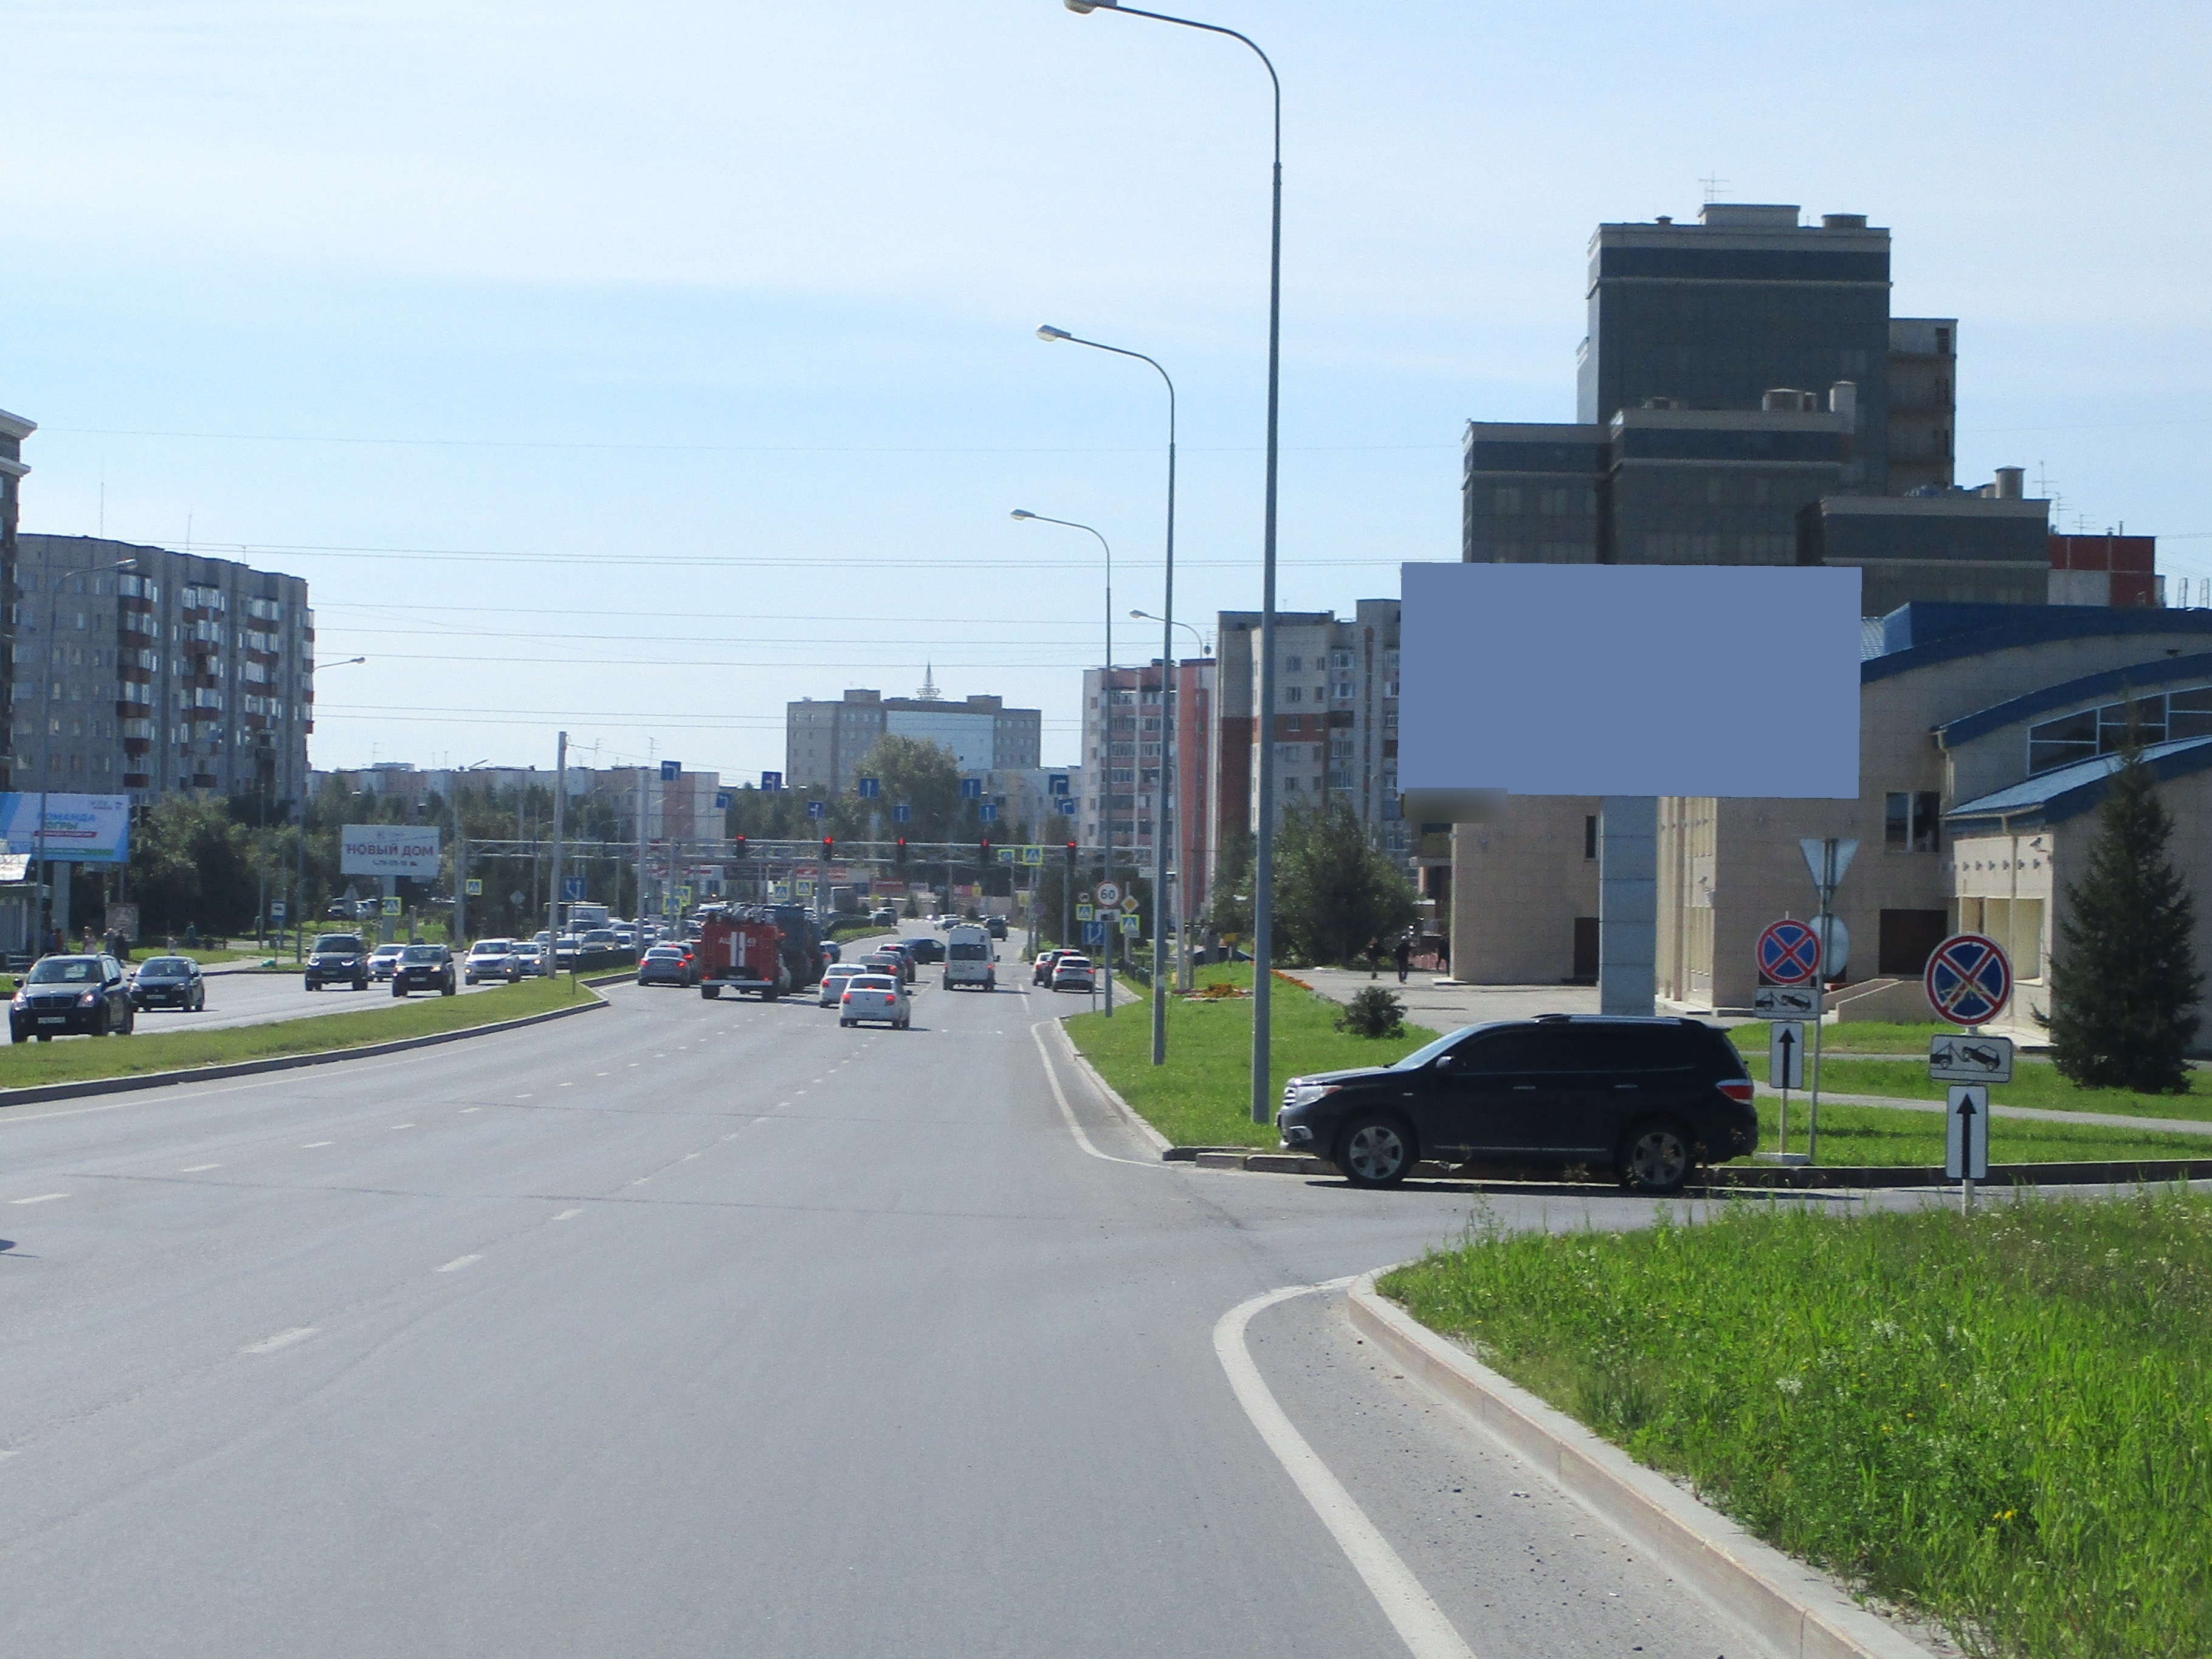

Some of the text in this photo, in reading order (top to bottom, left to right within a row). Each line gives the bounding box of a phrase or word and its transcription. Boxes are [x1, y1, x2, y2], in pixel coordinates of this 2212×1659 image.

[346, 843, 434, 857] НОВЫЙ ДОМ
[1101, 889, 1115, 899] 60
